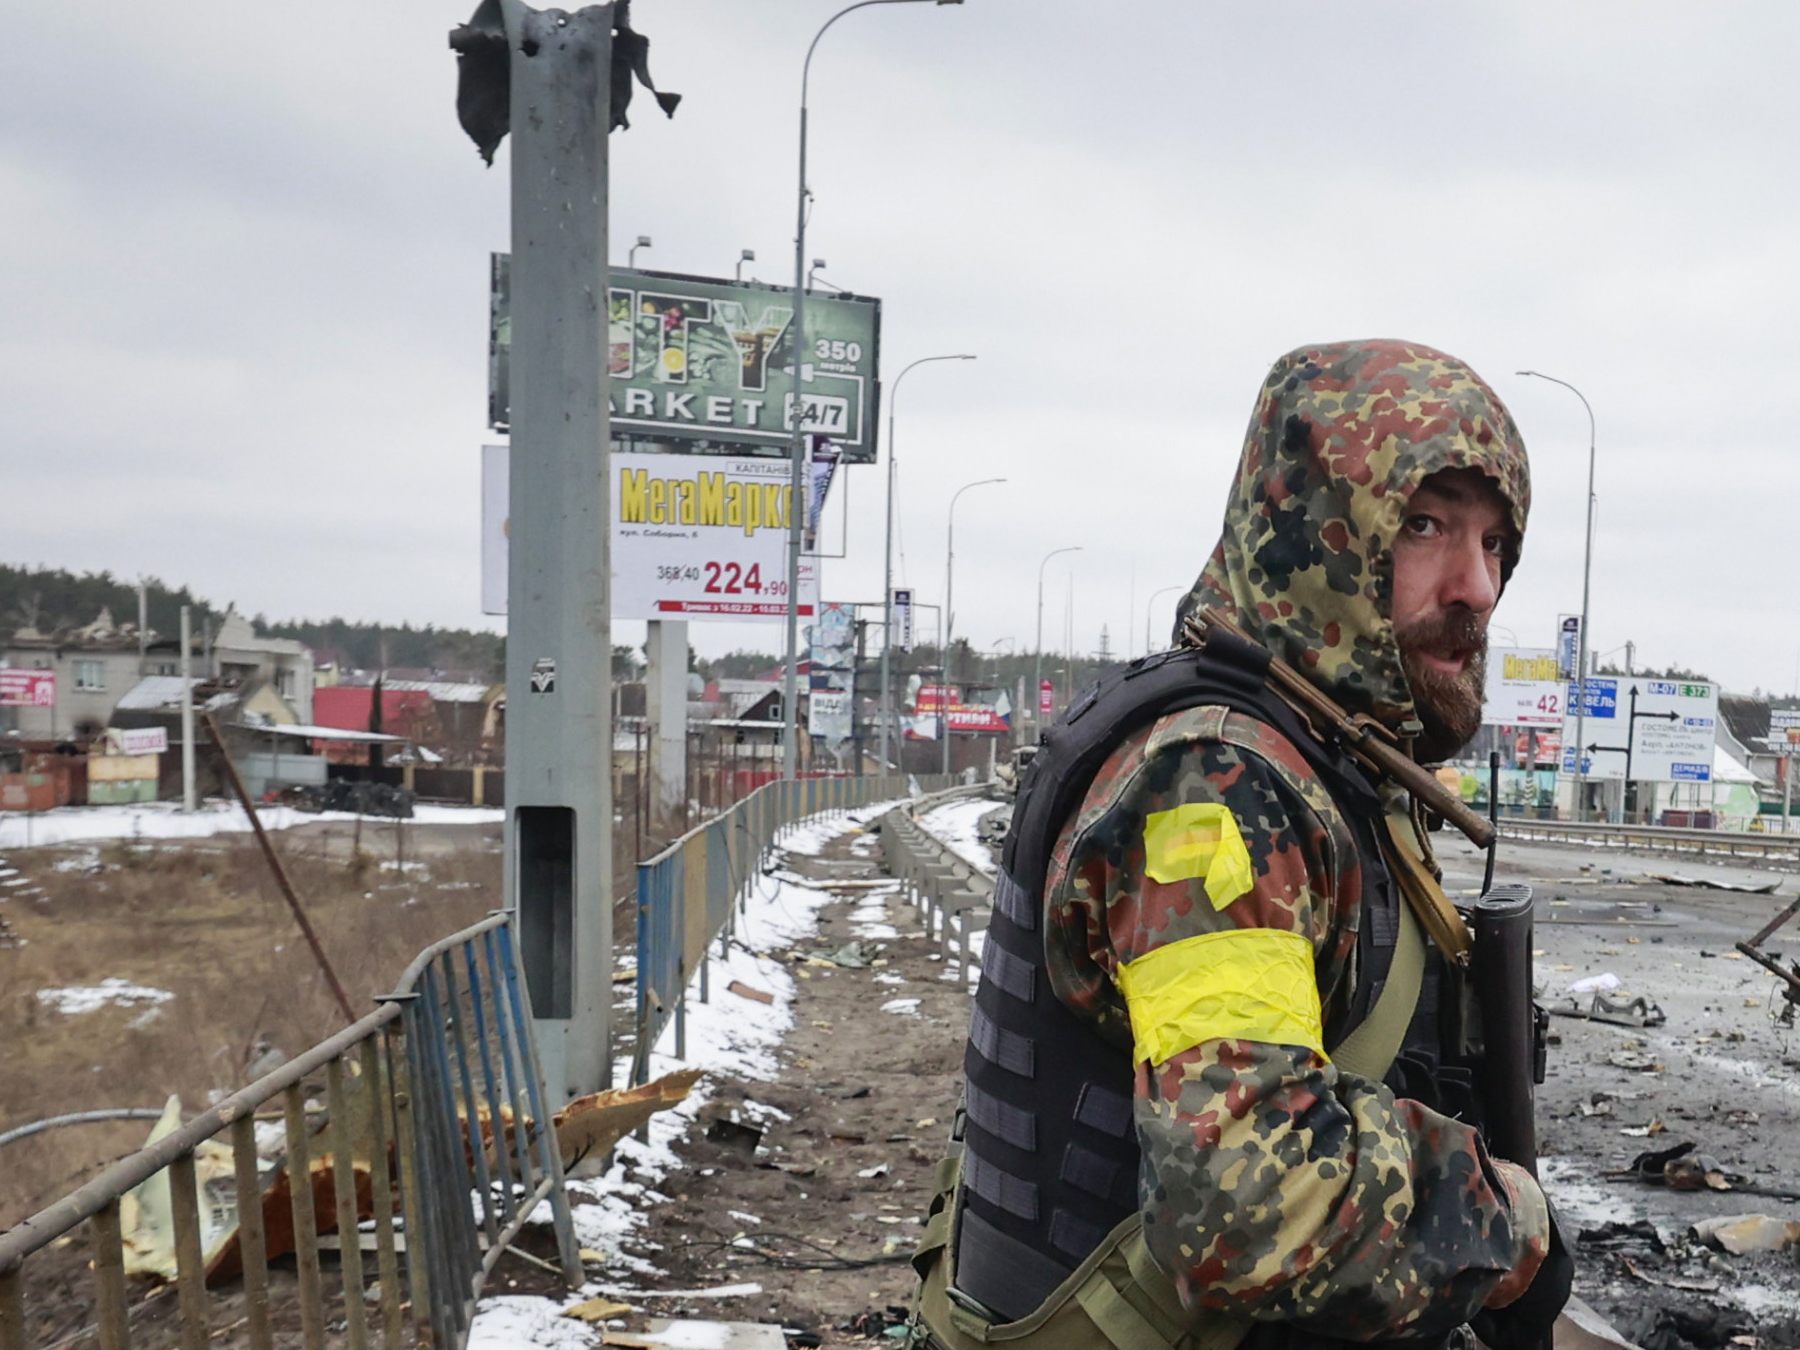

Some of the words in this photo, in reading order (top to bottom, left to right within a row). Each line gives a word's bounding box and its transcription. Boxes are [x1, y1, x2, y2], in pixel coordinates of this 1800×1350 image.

[815, 339, 862, 362] 350
[735, 464, 790, 475] КАПІТАНІВ
[1569, 695, 1615, 707] КВЕЛЬ
